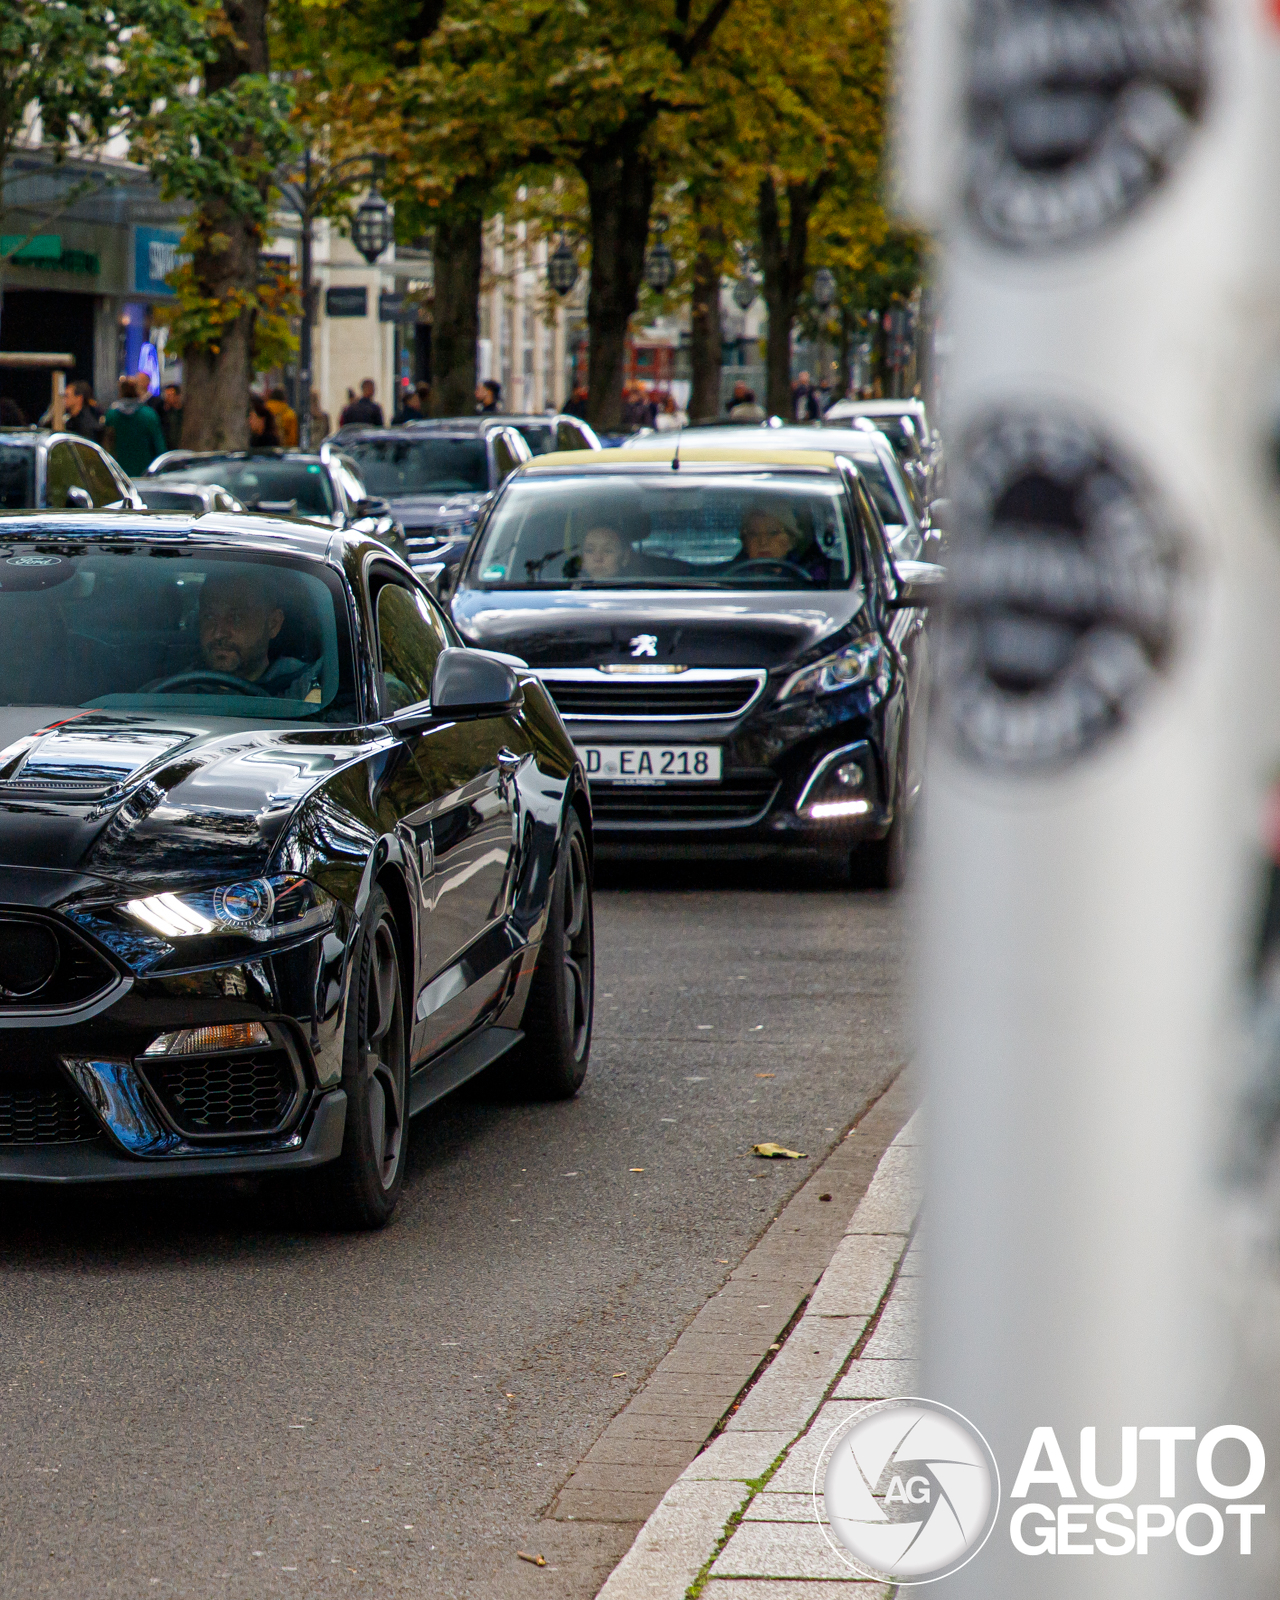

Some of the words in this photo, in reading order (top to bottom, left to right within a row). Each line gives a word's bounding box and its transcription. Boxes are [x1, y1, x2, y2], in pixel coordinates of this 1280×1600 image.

[586, 749, 602, 773] D
[620, 750, 654, 775] EA
[660, 751, 710, 775] 218
